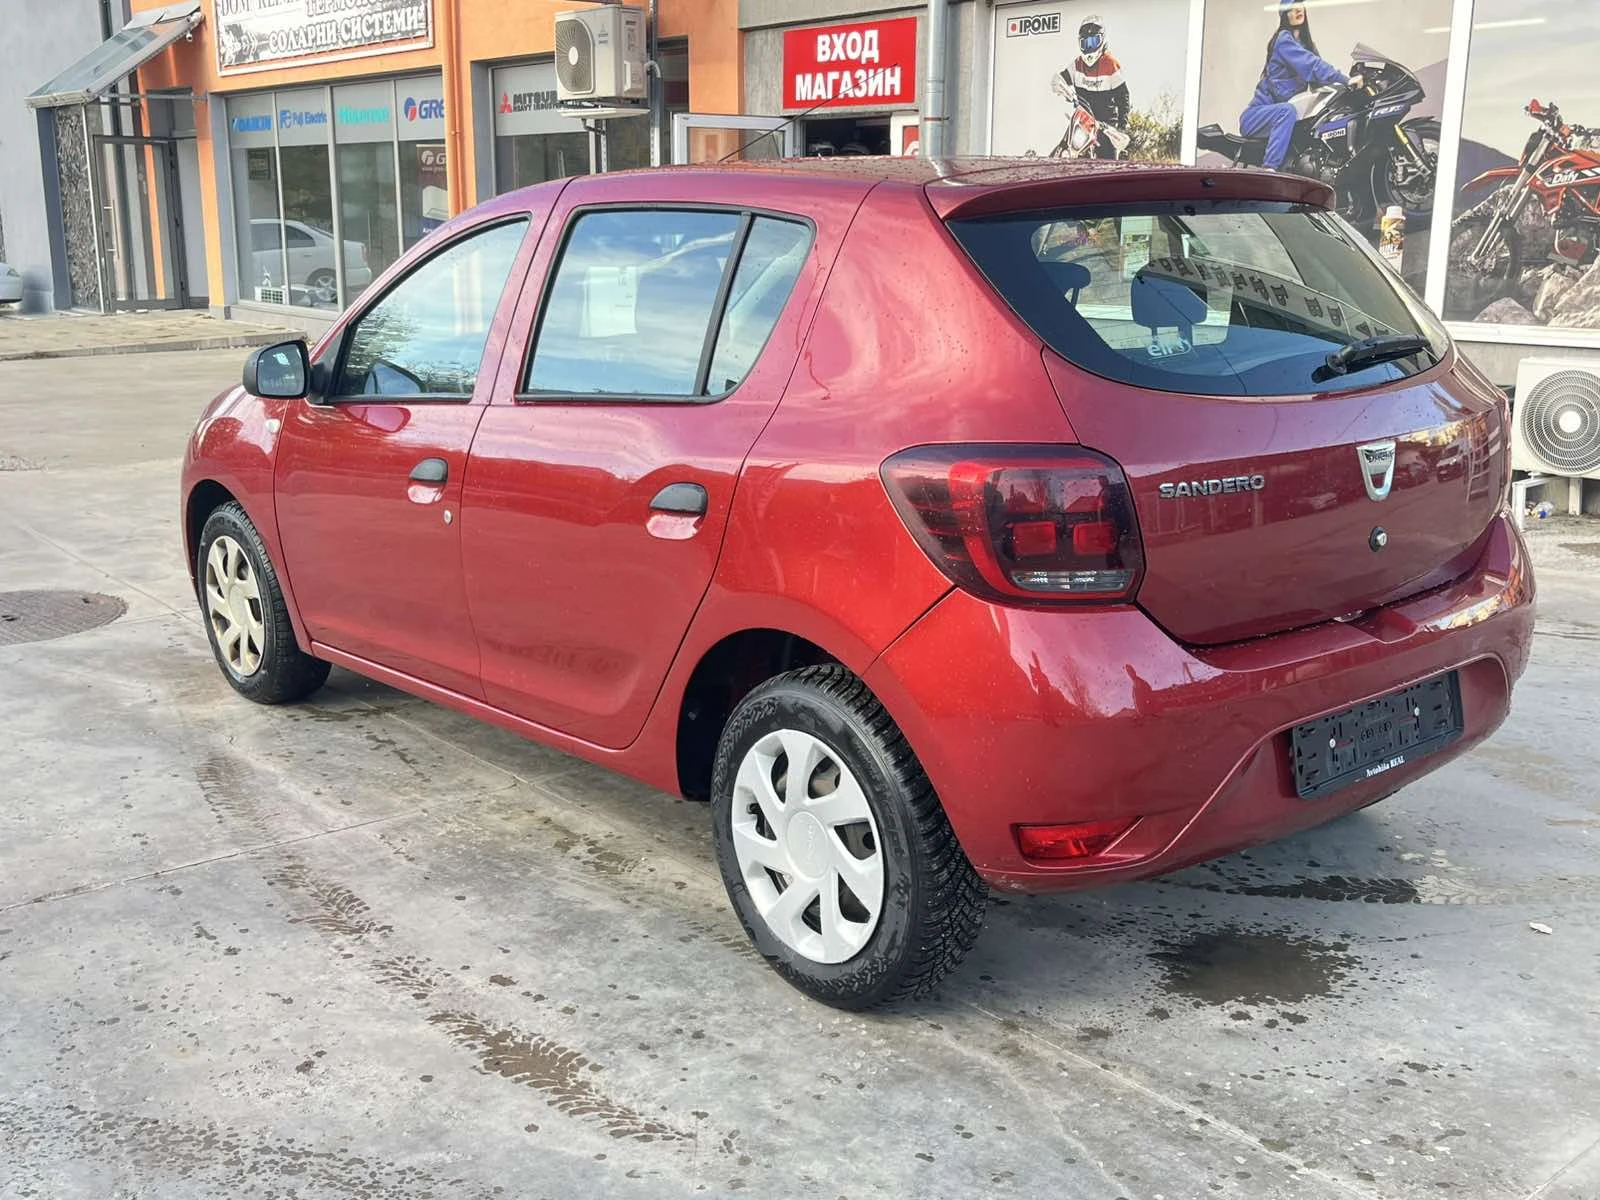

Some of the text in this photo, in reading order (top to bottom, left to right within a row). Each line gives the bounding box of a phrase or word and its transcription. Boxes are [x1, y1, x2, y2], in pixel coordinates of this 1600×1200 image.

[268, 6, 419, 53] СОЛАРНИ СИСТЕМИ
[1019, 15, 1059, 34] IPONE
[817, 29, 880, 64] ВХОД
[795, 65, 902, 101] МАГАЗИН
[1159, 473, 1266, 499] SANDERO
